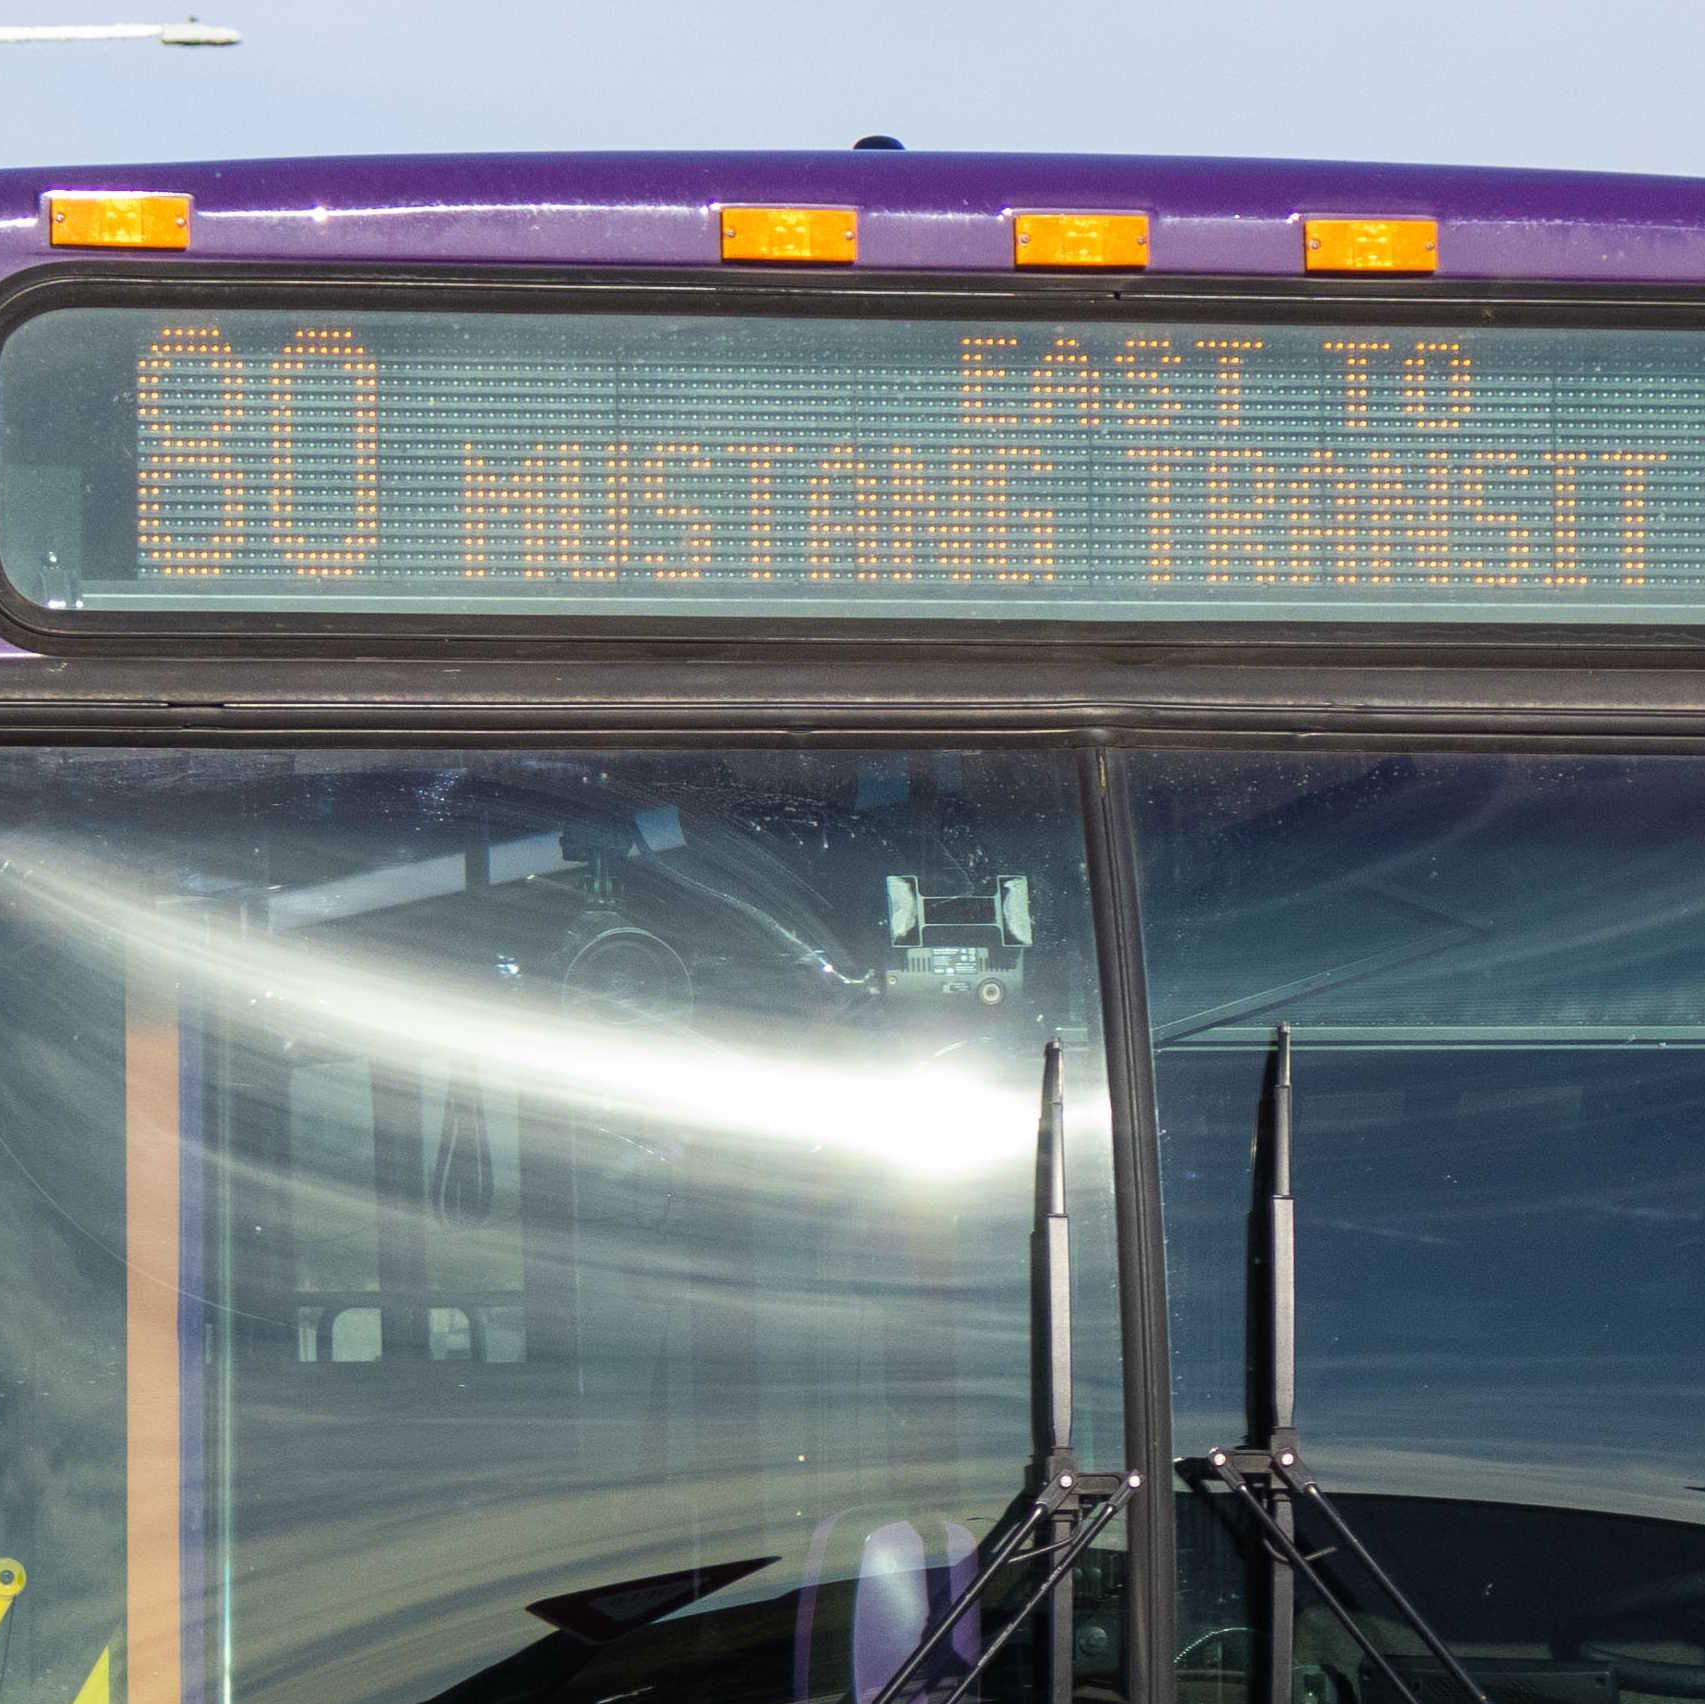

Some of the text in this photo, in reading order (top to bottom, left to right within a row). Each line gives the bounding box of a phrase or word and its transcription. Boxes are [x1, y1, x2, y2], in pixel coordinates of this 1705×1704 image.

[138, 327, 376, 576] 80
[961, 337, 1472, 428] EAST TO
[463, 442, 1054, 581] MUSTANG
[1127, 448, 1666, 585] TRANSIT
